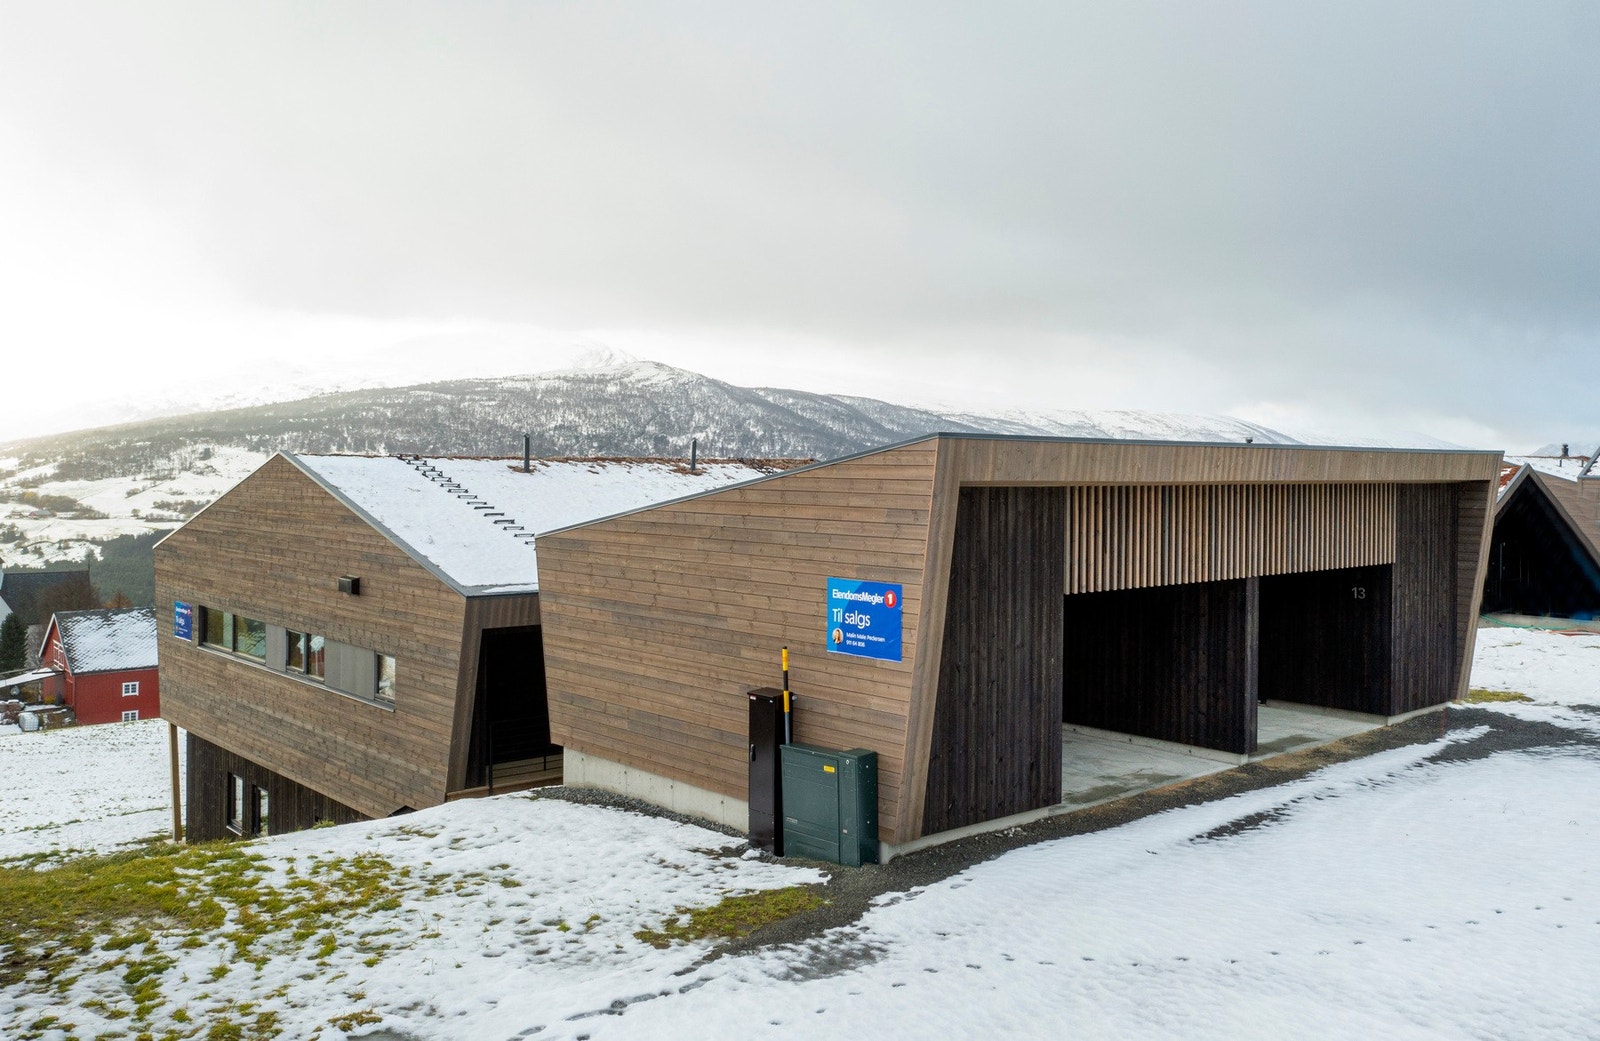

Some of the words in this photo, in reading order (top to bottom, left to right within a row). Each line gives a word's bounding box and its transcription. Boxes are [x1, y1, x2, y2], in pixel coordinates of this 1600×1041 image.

[832, 588, 884, 605] EiendomsMegler
[1351, 586, 1366, 599] 13
[832, 607, 843, 623] Til
[844, 610, 871, 629] salgs
